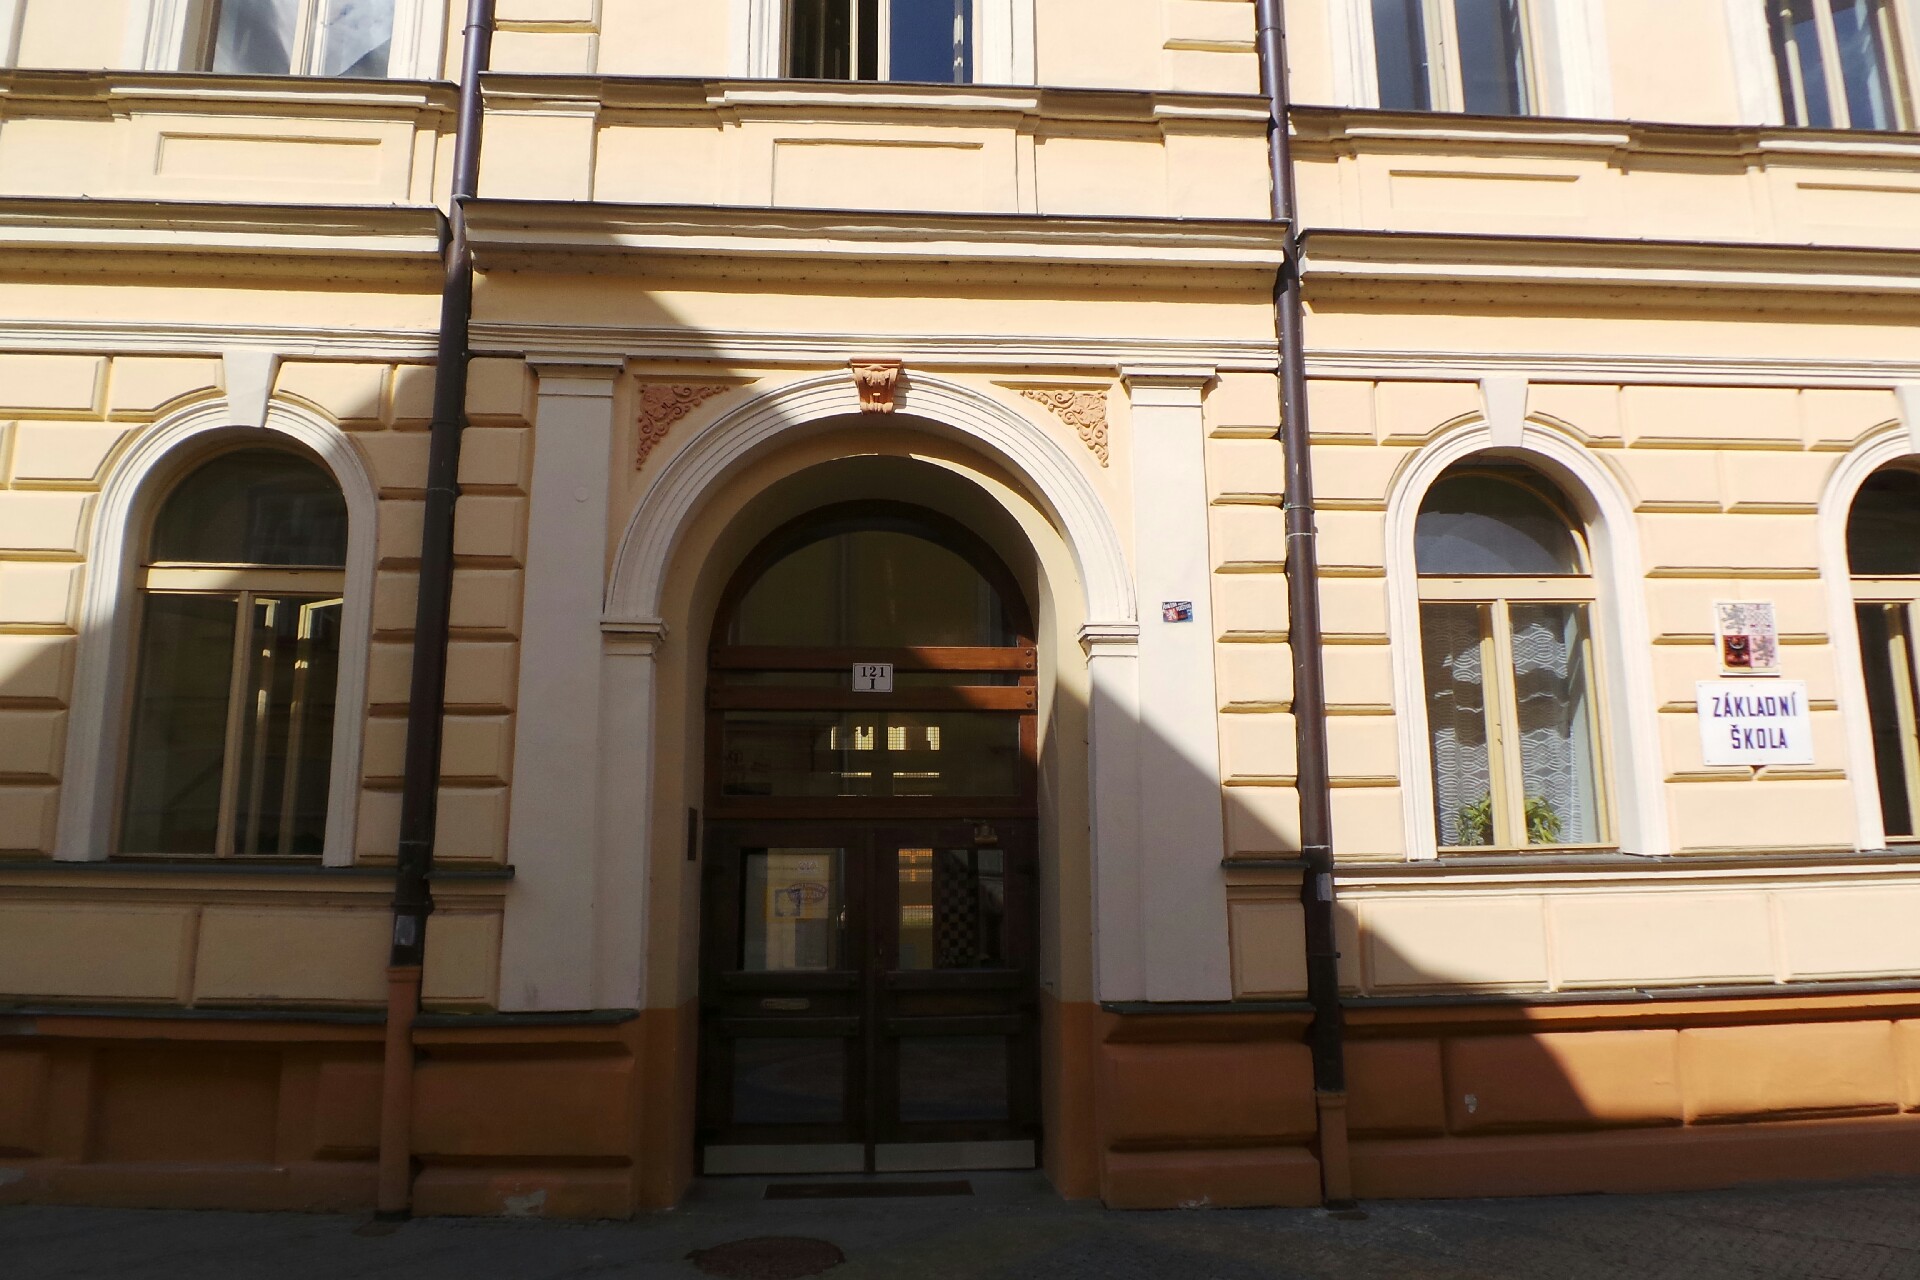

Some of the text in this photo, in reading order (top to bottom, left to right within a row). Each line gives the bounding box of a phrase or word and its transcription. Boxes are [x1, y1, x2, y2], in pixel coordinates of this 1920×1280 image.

[861, 666, 885, 678] 121
[1712, 691, 1798, 717] ZÁKLADNÍ
[1730, 724, 1789, 749] ŠKOLA
